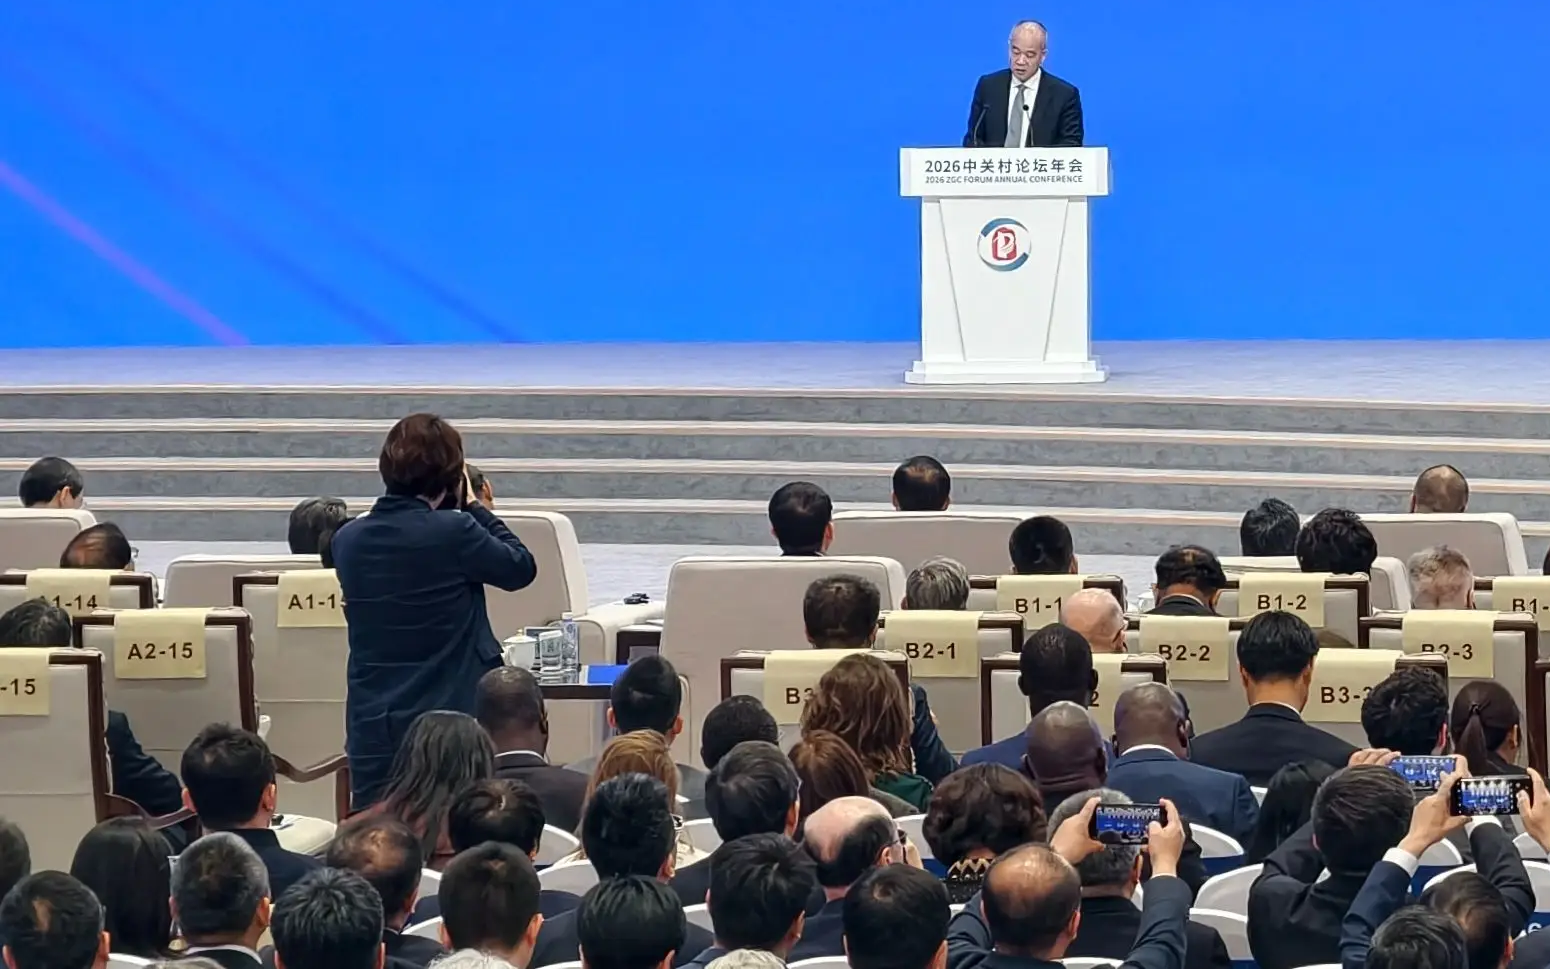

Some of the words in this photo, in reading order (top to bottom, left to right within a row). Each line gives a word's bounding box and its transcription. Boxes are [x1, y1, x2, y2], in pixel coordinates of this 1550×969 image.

[925, 158, 1083, 174] 2026中关村论坛年会
[925, 176, 945, 184] 2026
[945, 176, 962, 184] ZGC
[963, 175, 993, 184] FORUM
[994, 175, 1027, 183] ANNUAL
[1028, 175, 1083, 183] CONFERENCE
[1015, 596, 1062, 613] B1-1
[1257, 594, 1307, 610] B1-2
[127, 641, 193, 661] A2-15
[906, 642, 956, 660] B2-1
[1158, 644, 1211, 662] B2-2
